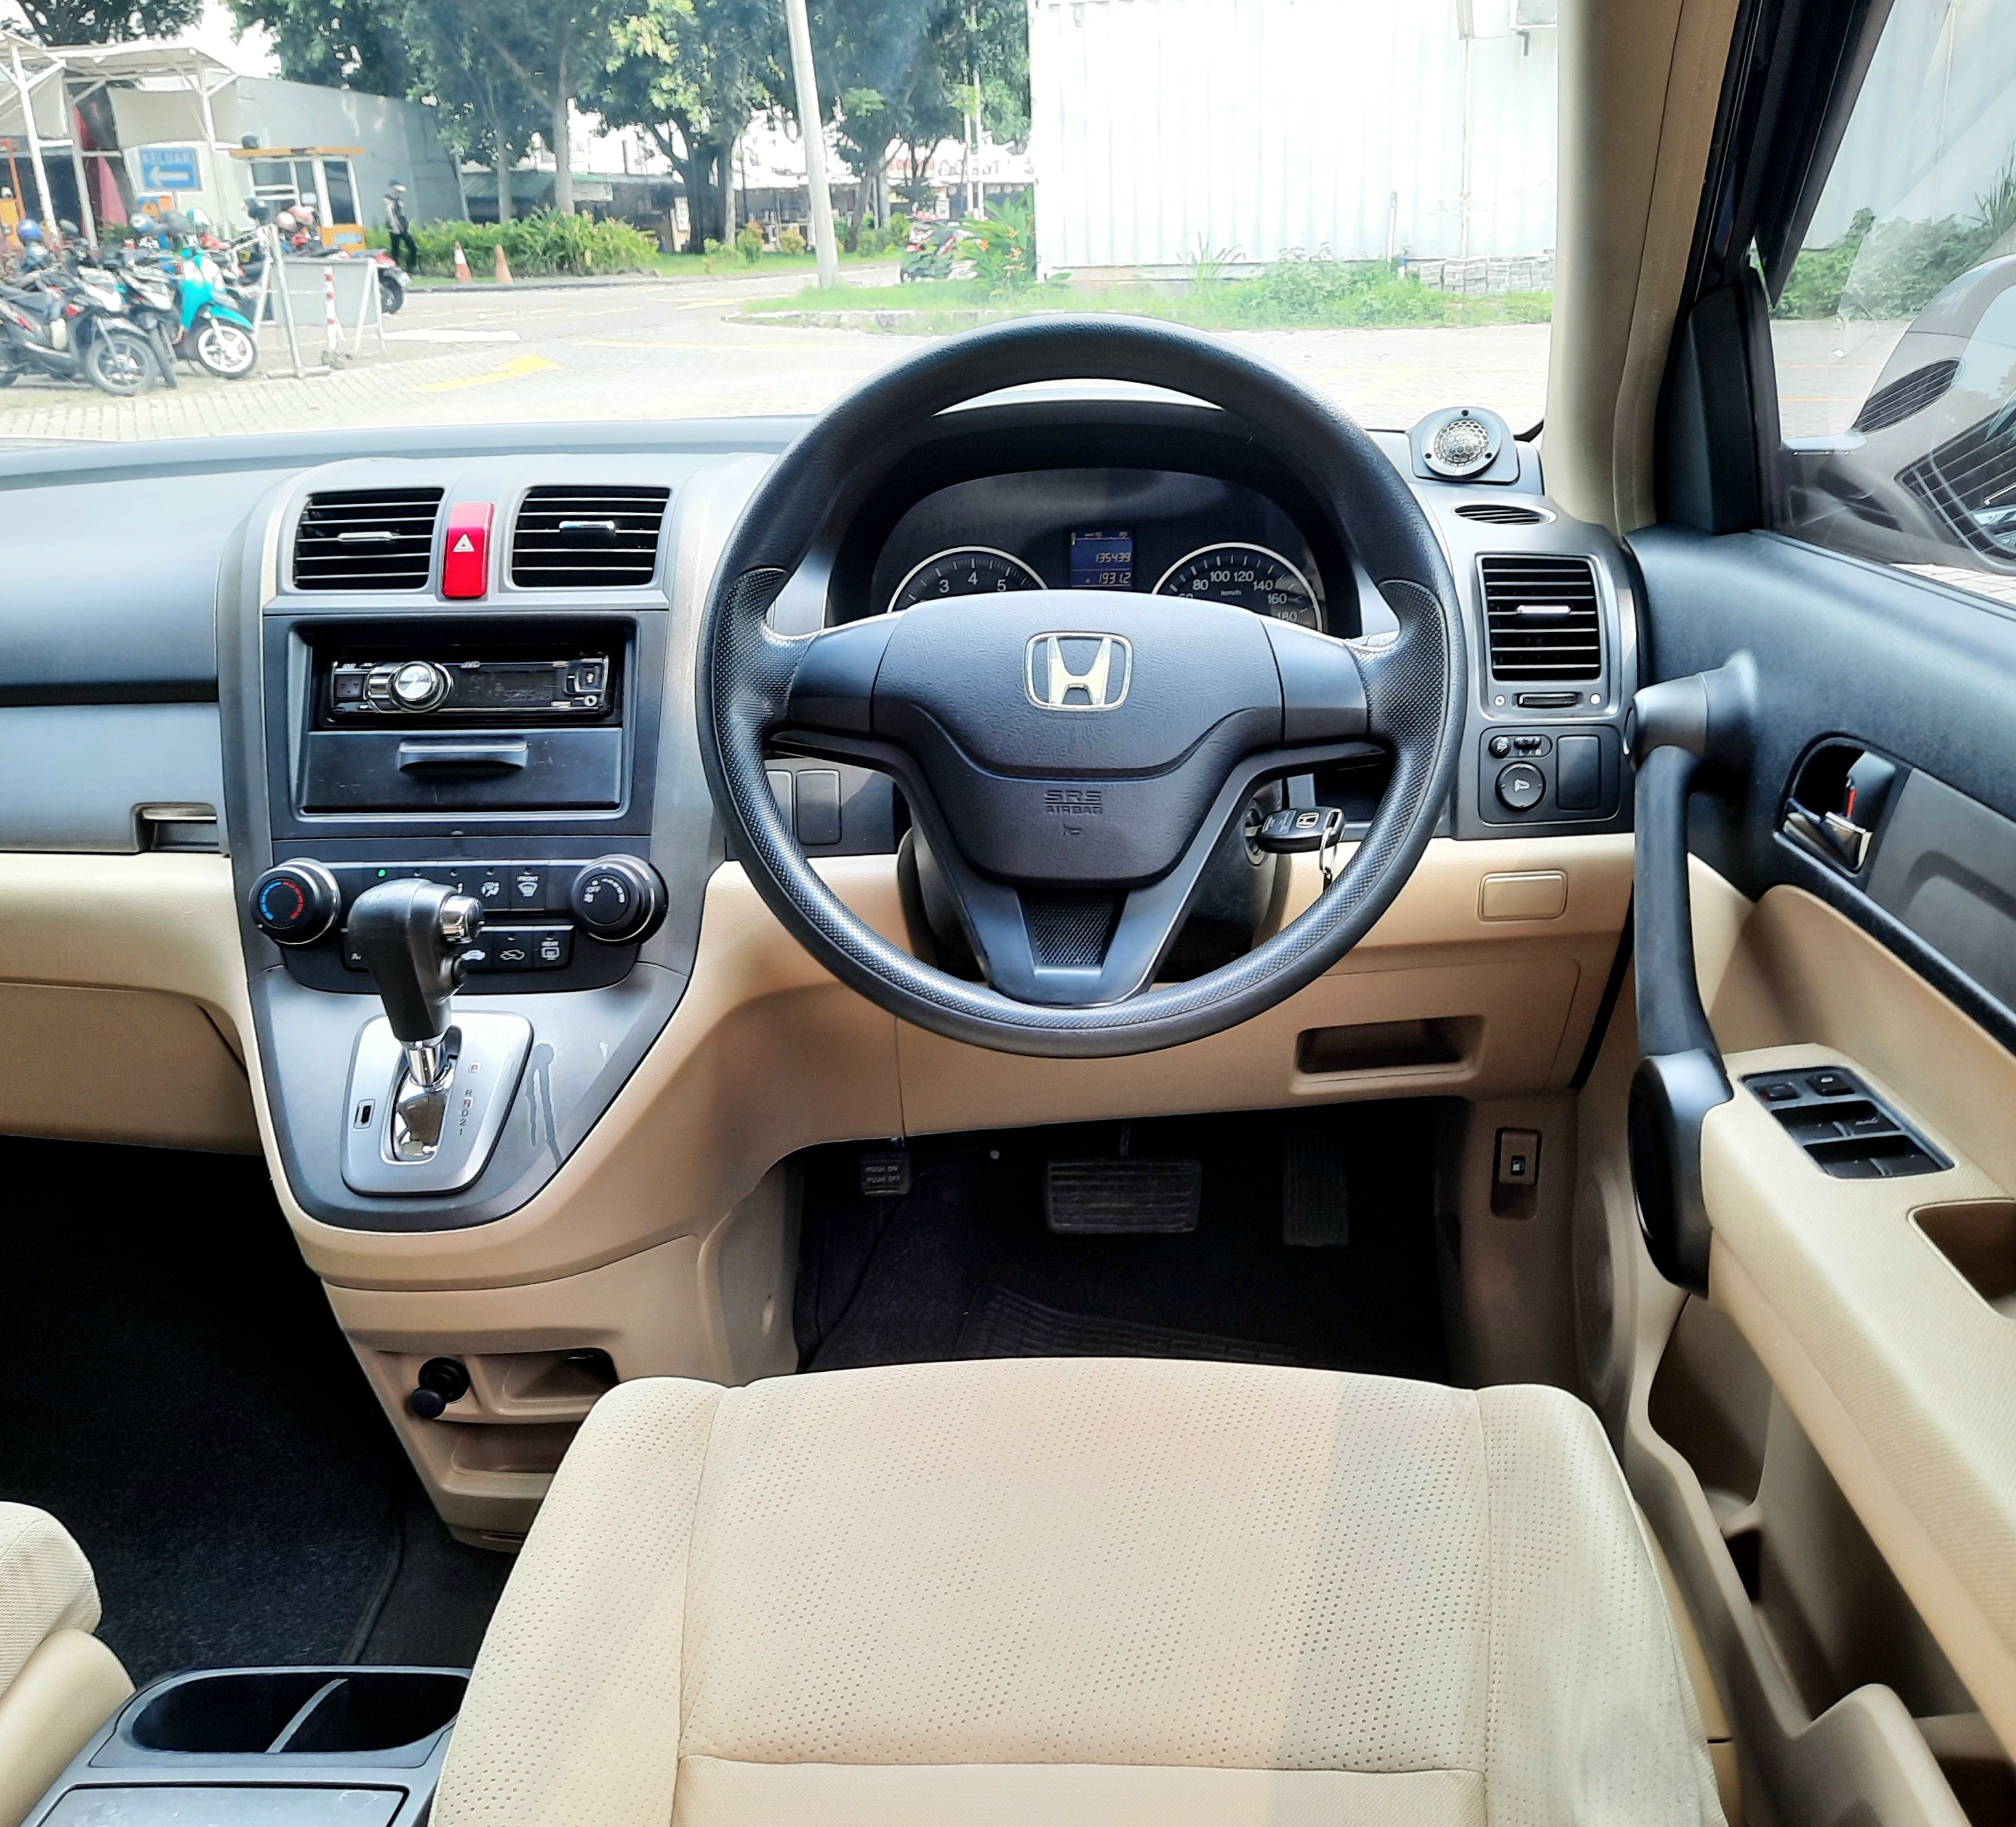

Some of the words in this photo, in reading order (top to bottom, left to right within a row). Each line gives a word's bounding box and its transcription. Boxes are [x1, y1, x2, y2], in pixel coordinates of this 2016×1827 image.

[1096, 552, 1131, 563] 135439
[939, 580, 949, 593] 3
[967, 571, 978, 585] 4
[997, 579, 1006, 591] 5
[1192, 580, 1208, 591] 80
[1210, 571, 1230, 582] 100
[1234, 571, 1254, 582] 120
[1253, 580, 1273, 591] 140
[1267, 593, 1287, 604] 160
[1277, 611, 1296, 622] 180
[1045, 790, 1101, 802] SRS
[1046, 805, 1102, 814] AIRBAG
